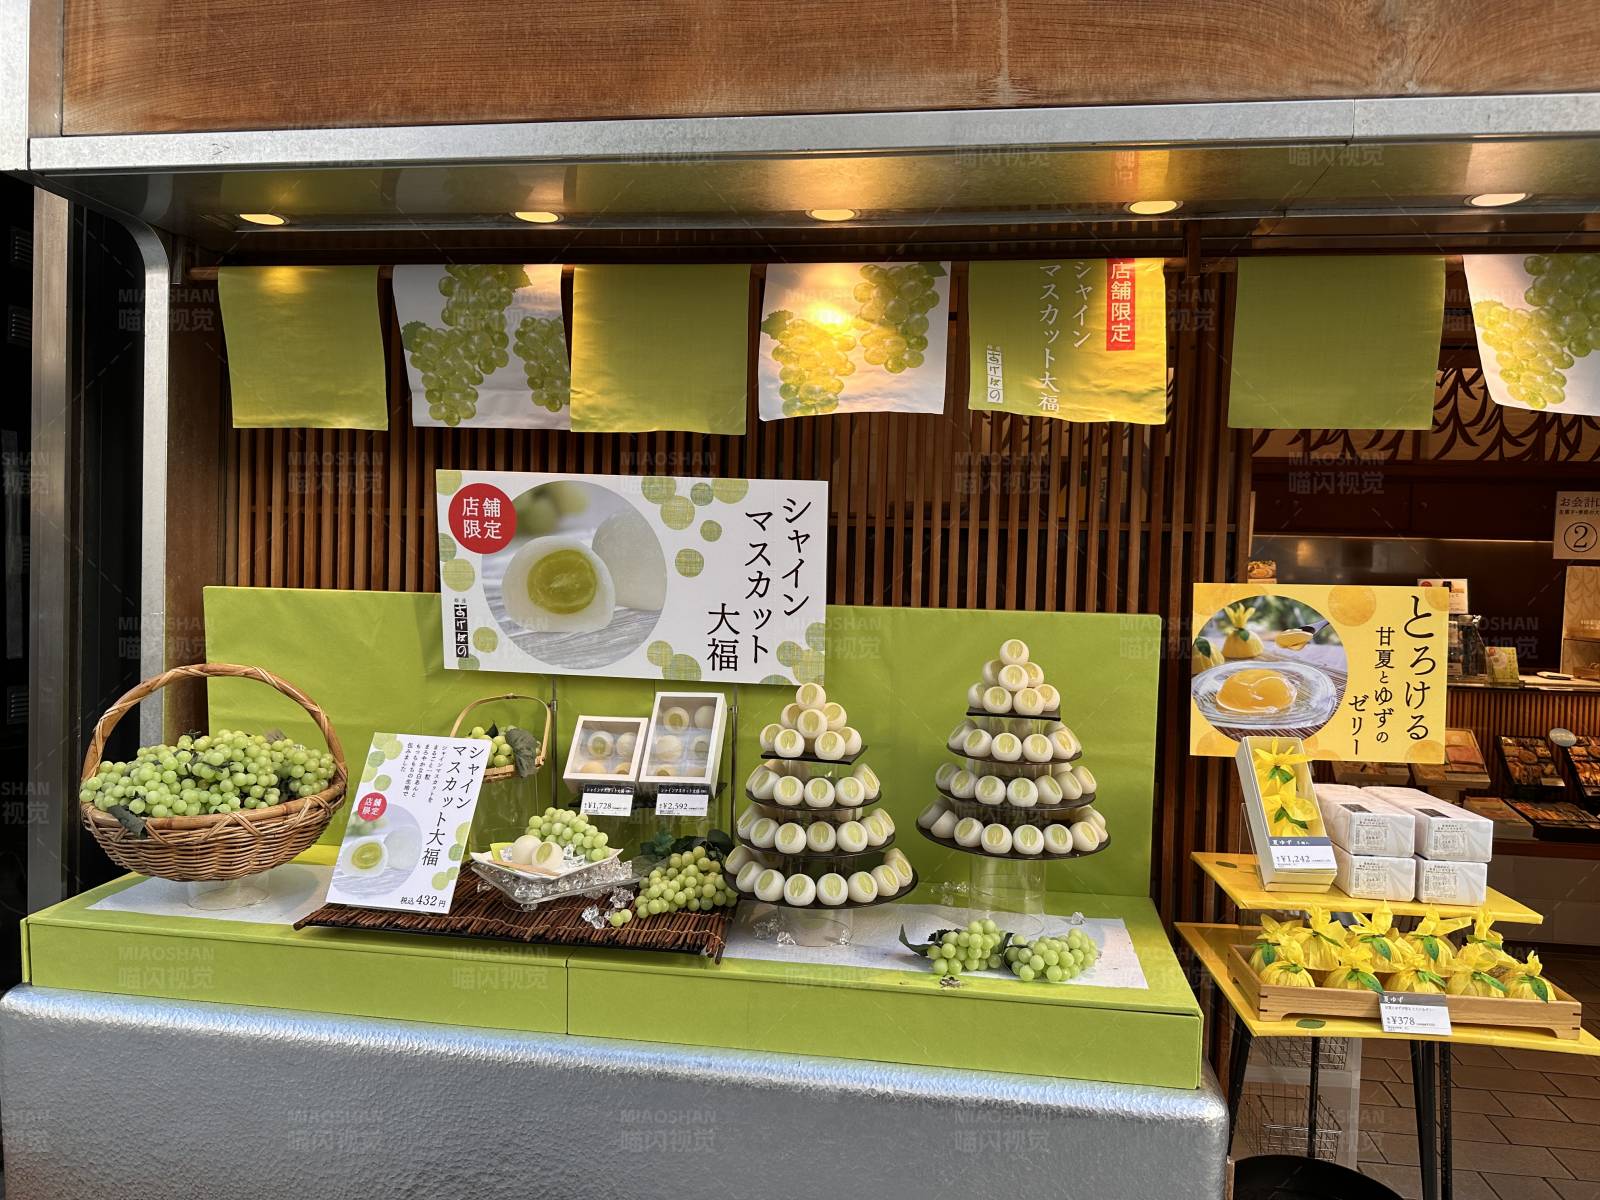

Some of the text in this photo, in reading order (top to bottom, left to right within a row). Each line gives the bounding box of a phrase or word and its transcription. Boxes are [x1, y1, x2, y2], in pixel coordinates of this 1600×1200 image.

[1073, 261, 1093, 349] シャイン
[1110, 261, 1132, 344] 店舗限定
[1039, 262, 1061, 412] マスカット大福
[462, 497, 501, 517] 店舗
[463, 519, 502, 540] 限定
[744, 509, 774, 664] マスカット
[781, 497, 813, 617] シャイン
[706, 603, 741, 672] 大福
[1402, 595, 1436, 741] とろける
[1373, 626, 1396, 743] 甘夏とゆずの
[1348, 694, 1370, 756] ゼリー
[364, 797, 382, 808] 店舗
[421, 744, 466, 867] マスカット大福
[456, 745, 485, 809] シャイン
[587, 801, 612, 810] ¥1,728
[663, 801, 688, 811] ¥2,592
[361, 806, 380, 817] 限定
[1280, 855, 1311, 864] ¥1,242
[1390, 1015, 1416, 1026] ¥378
